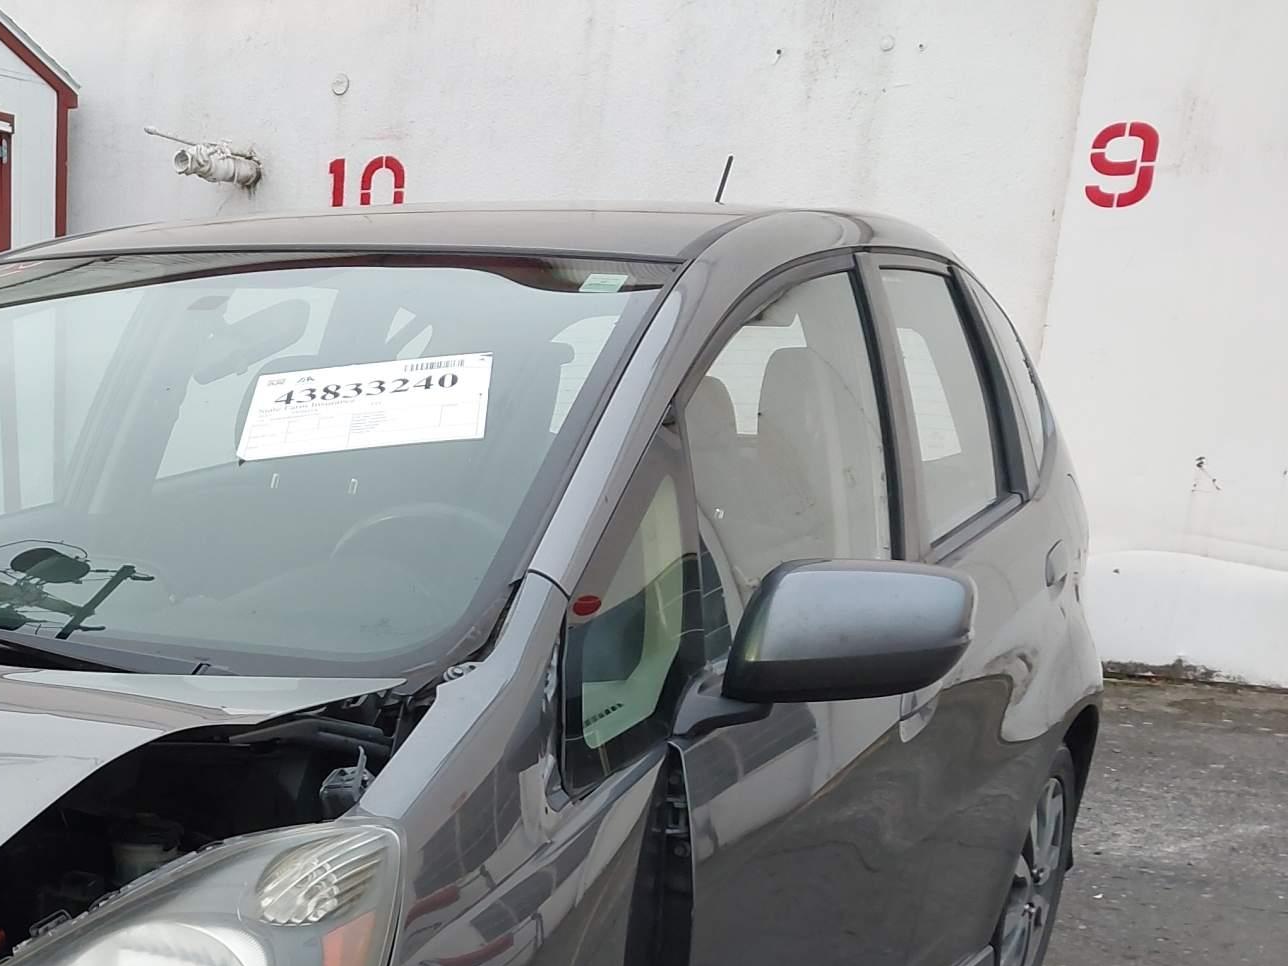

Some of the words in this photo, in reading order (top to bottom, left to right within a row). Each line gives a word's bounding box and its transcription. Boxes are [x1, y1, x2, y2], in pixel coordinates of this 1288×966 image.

[329, 156, 405, 207] 10
[1085, 122, 1159, 208] 9
[274, 372, 459, 406] 43833240
